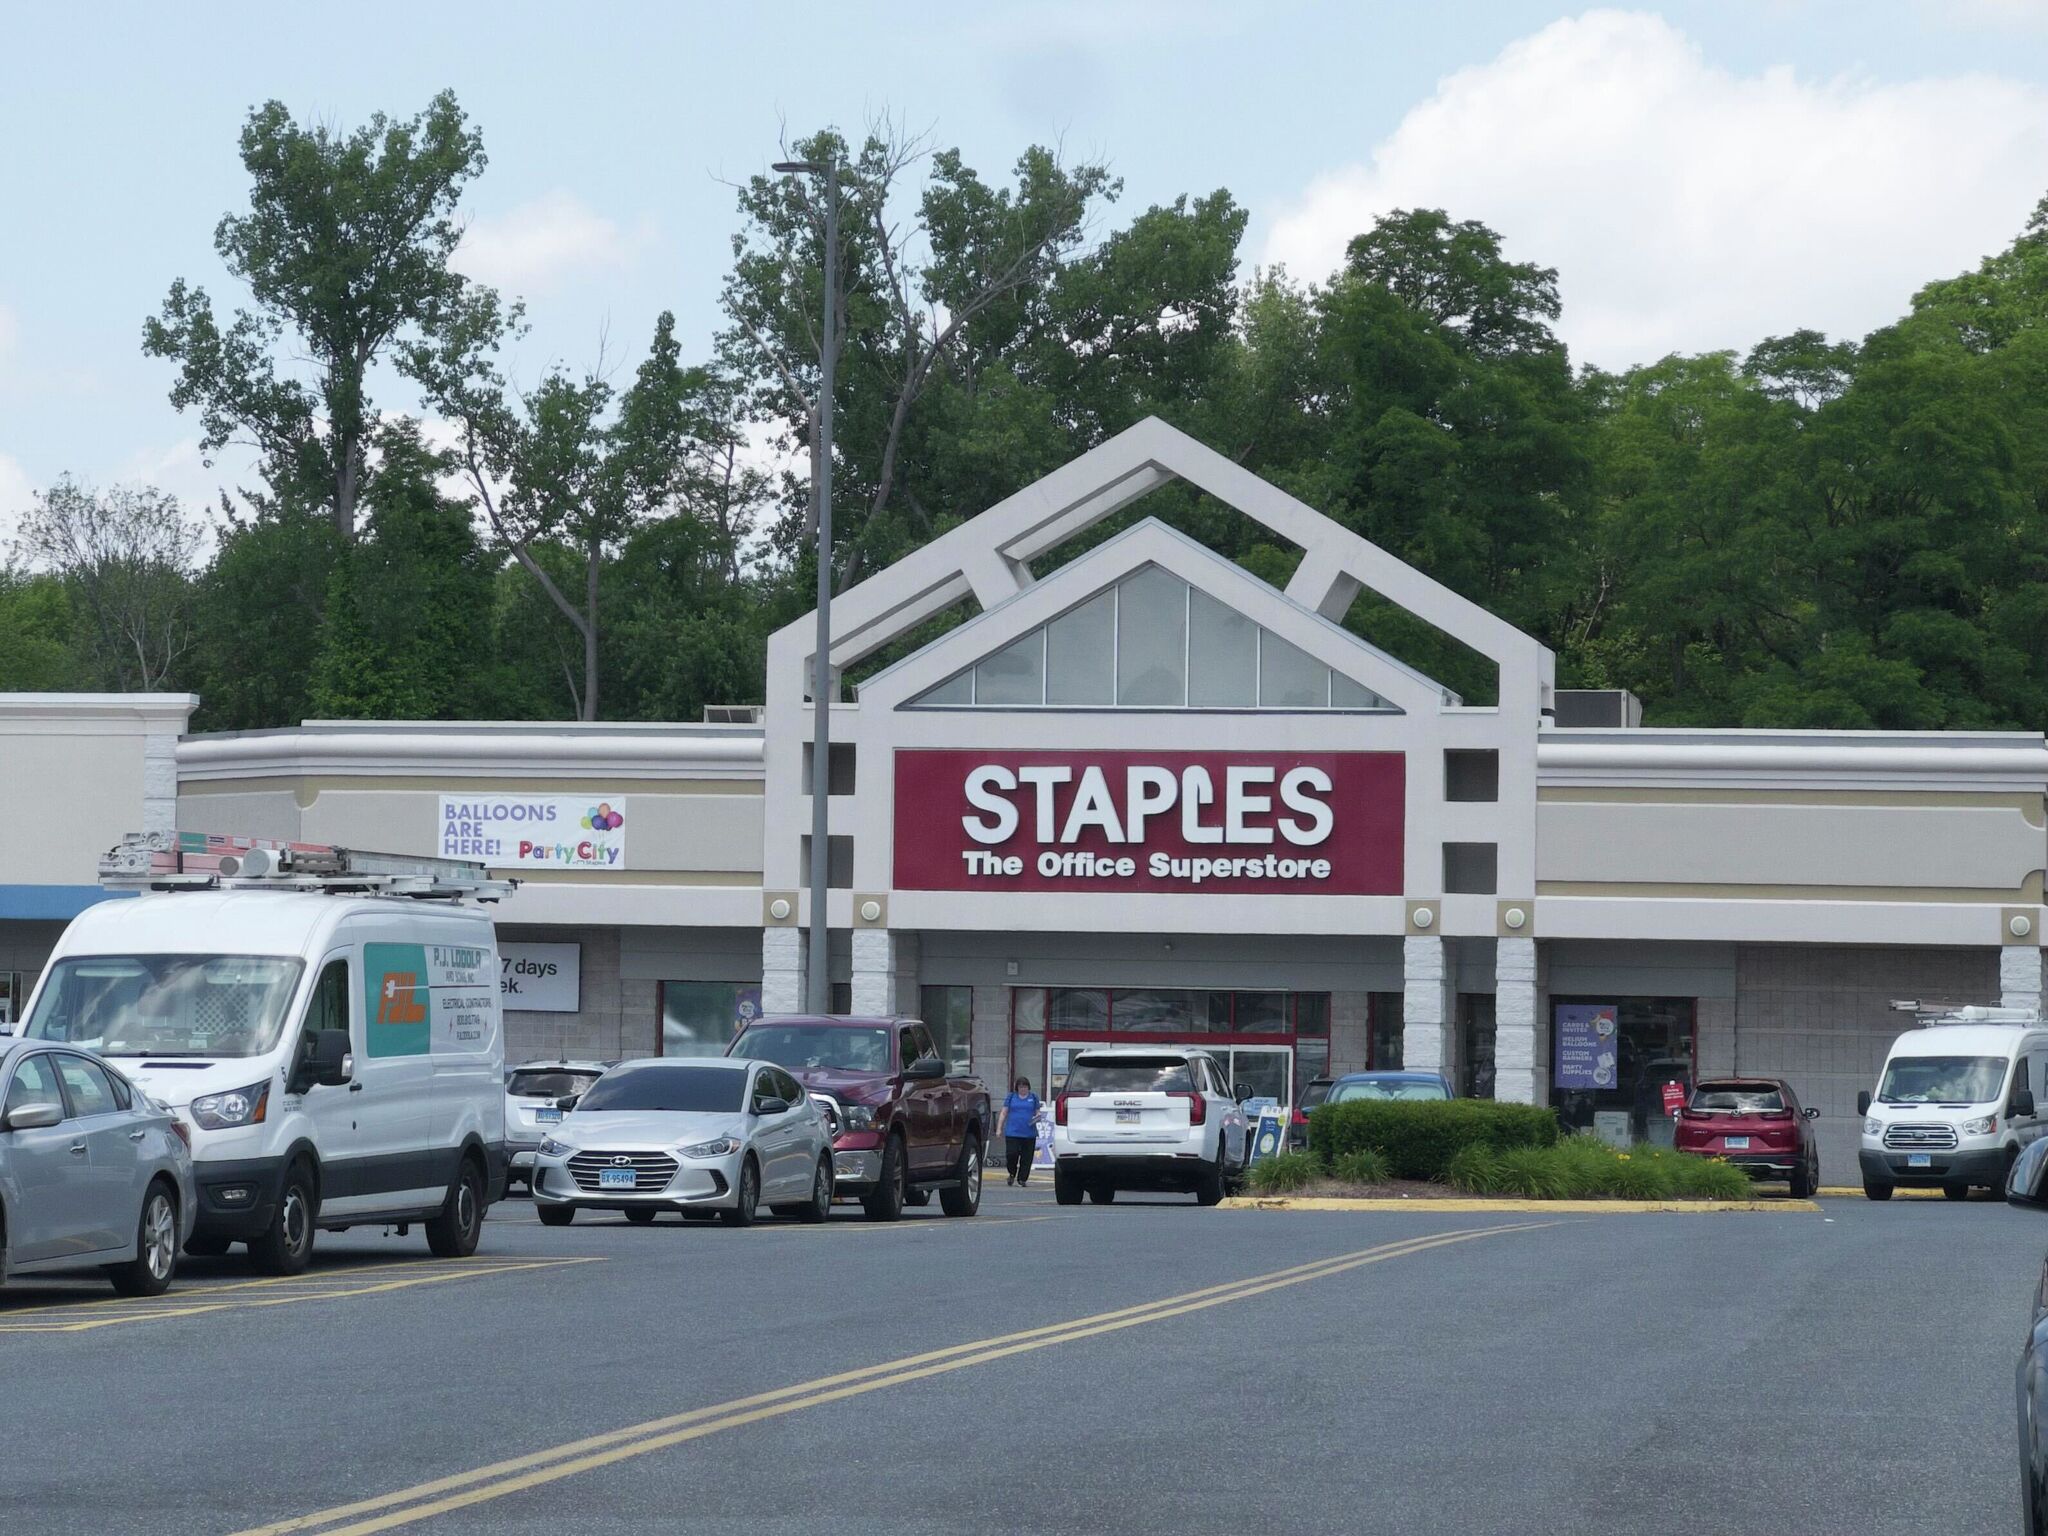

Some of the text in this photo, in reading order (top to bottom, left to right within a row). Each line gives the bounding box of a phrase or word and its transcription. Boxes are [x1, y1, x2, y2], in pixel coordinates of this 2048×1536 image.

[445, 804, 557, 821] BALLOONS
[961, 765, 1334, 846] STAPLES
[444, 821, 483, 837] ARE
[444, 839, 500, 855] HERE!
[962, 851, 1331, 883] The Office Superstore
[501, 958, 557, 978] 7 days
[500, 977, 523, 994] ek.
